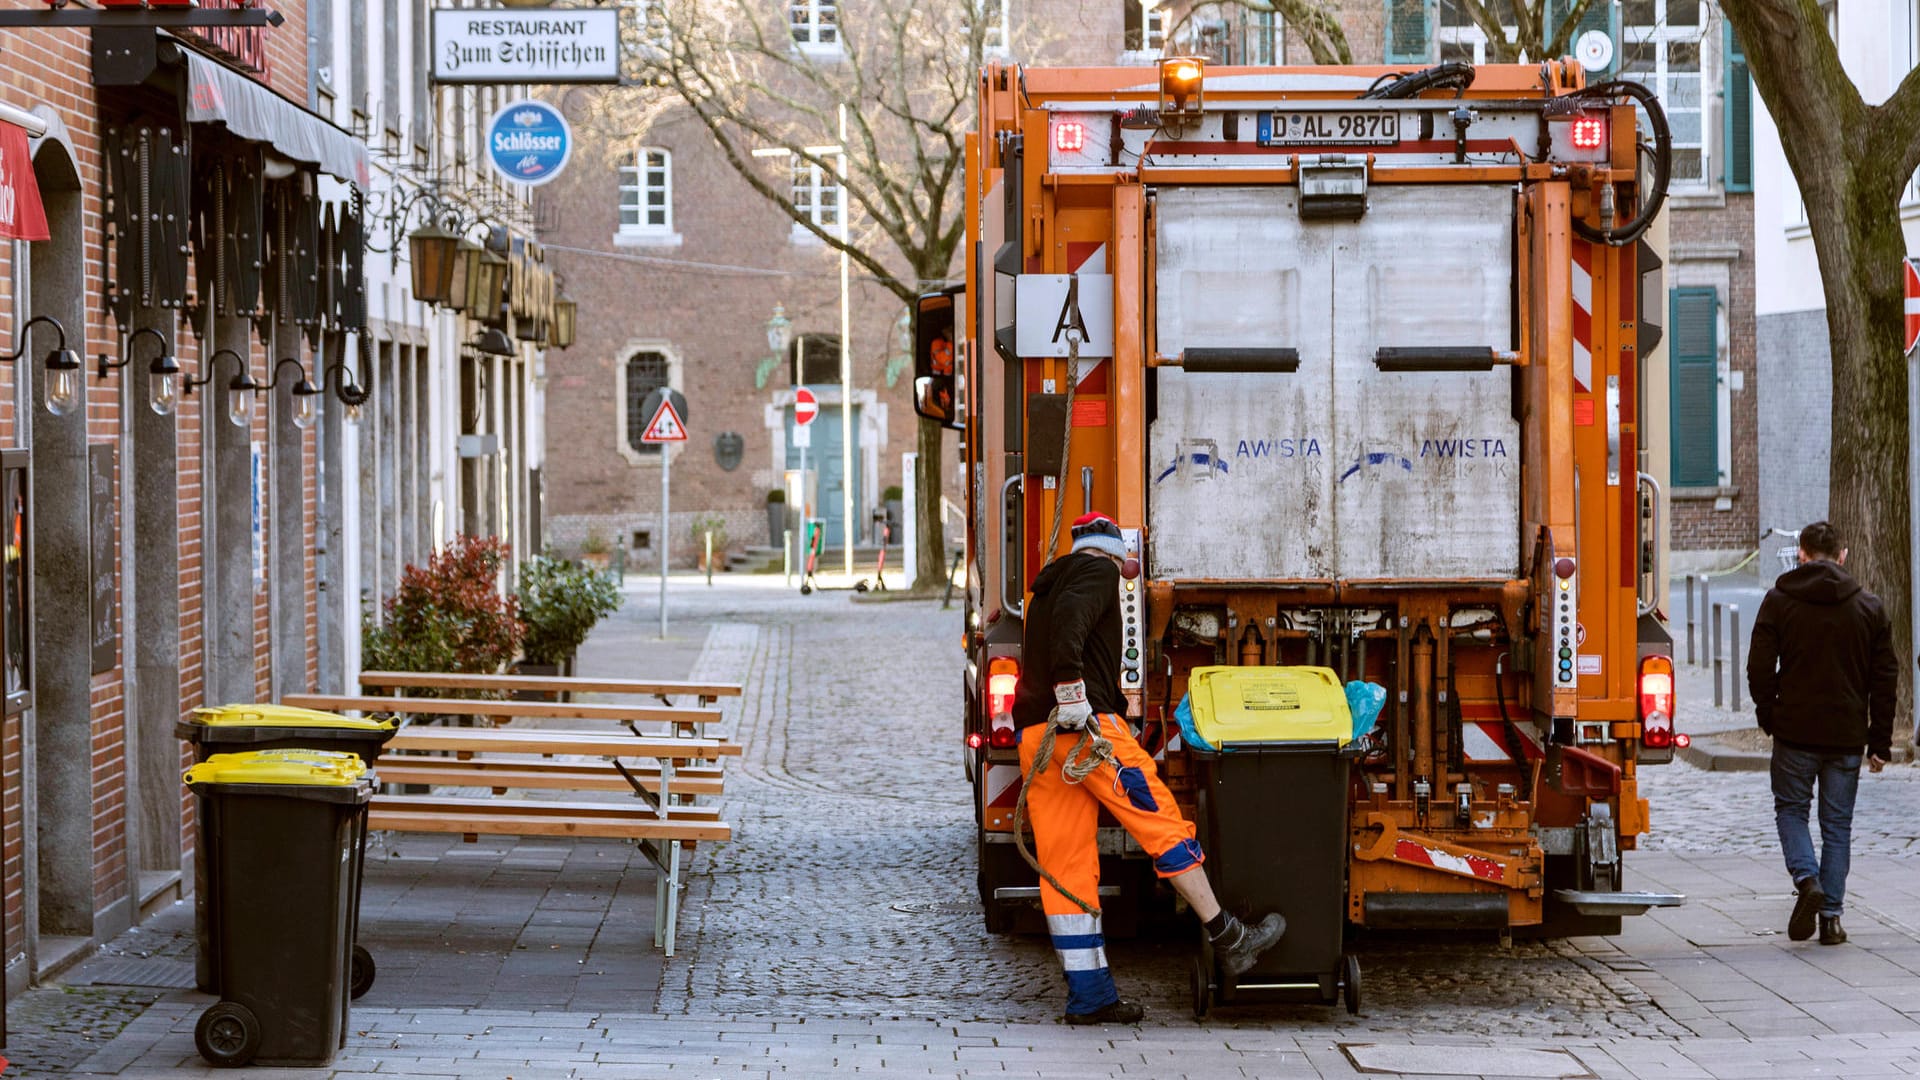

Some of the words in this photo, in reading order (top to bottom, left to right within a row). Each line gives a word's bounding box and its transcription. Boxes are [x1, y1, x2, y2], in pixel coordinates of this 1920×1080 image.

[468, 20, 587, 36] RESTAURANT
[446, 40, 492, 71] Zum
[497, 40, 606, 69] Schiffchen
[1273, 115, 1287, 138] D
[1303, 115, 1332, 138] AL
[1338, 115, 1395, 137] 9870
[494, 131, 561, 152] Schlösser
[1051, 283, 1091, 343] A
[1236, 438, 1321, 458] AWISTA
[1420, 438, 1507, 458] AWISTA
